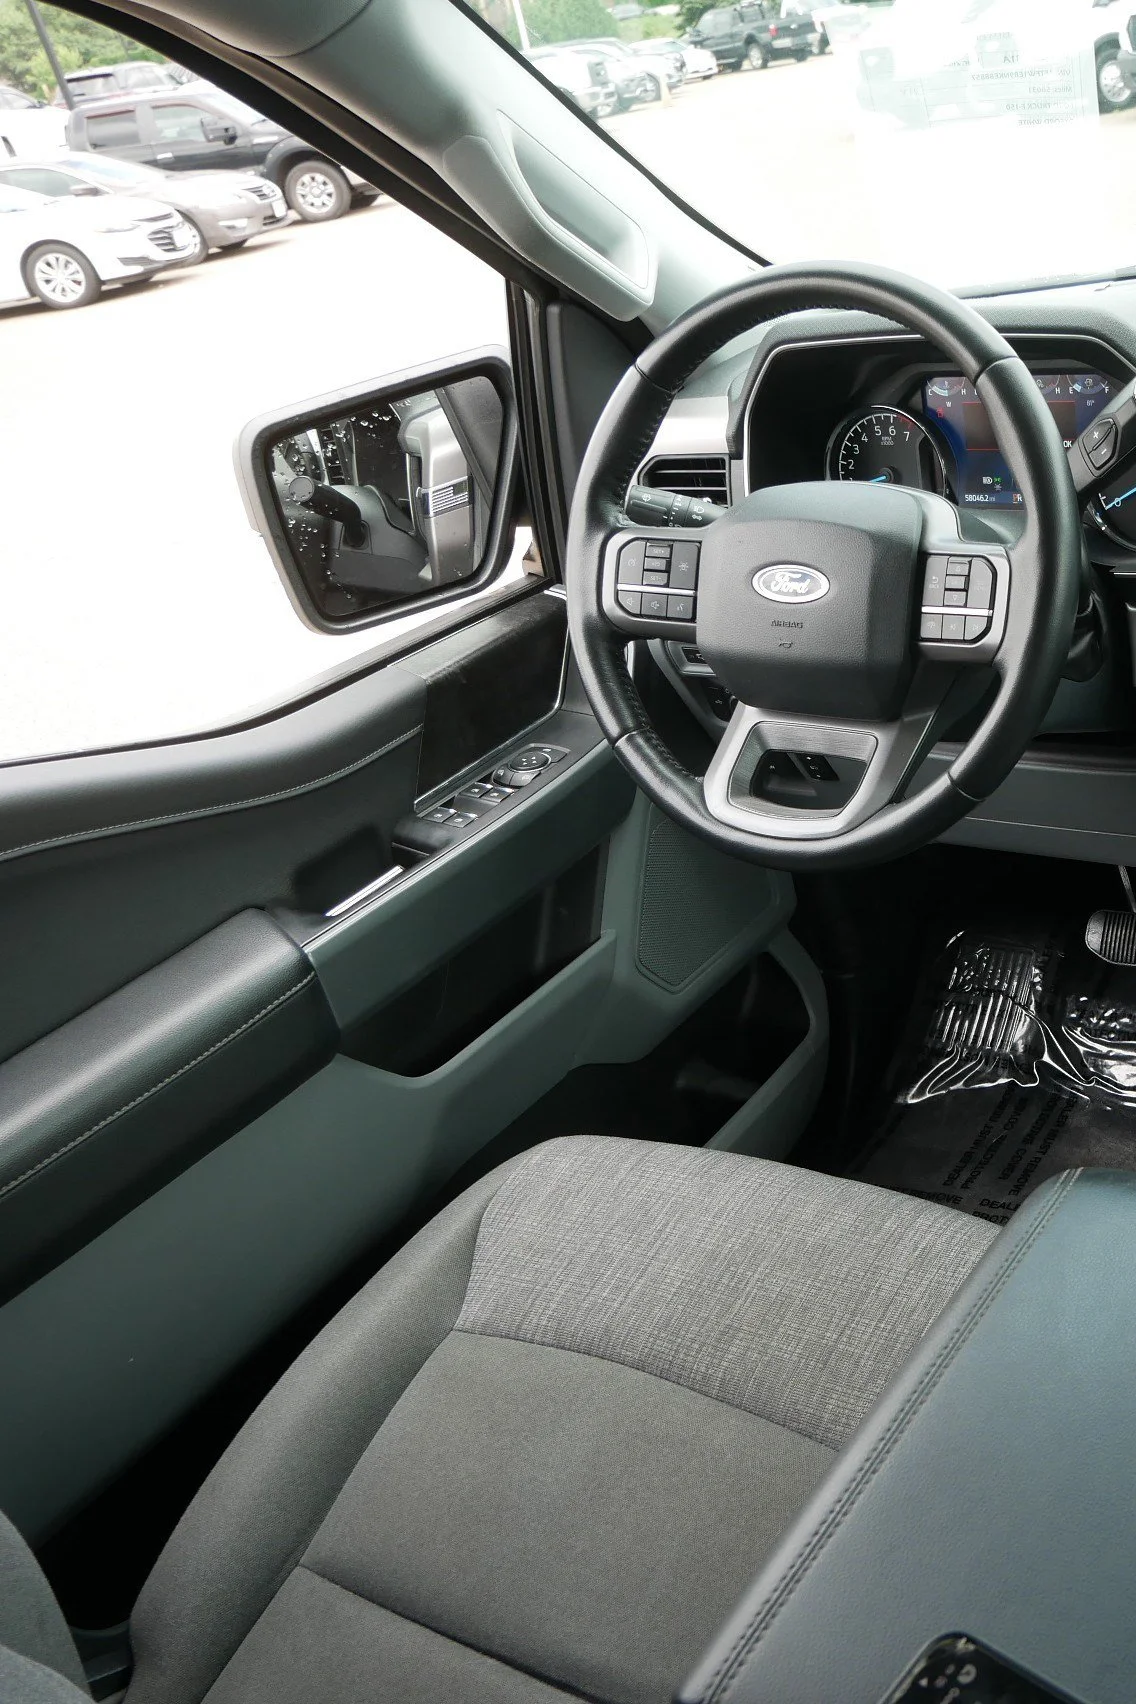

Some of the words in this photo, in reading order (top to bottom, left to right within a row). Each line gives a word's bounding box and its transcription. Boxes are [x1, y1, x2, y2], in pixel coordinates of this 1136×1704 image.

[961, 388, 967, 396] H
[874, 425, 882, 436] 5
[888, 425, 896, 436] 6
[861, 433, 868, 442] 4
[903, 431, 910, 442] 7
[1063, 440, 1072, 448] OK
[853, 444, 860, 454] 3
[848, 460, 855, 469] 2
